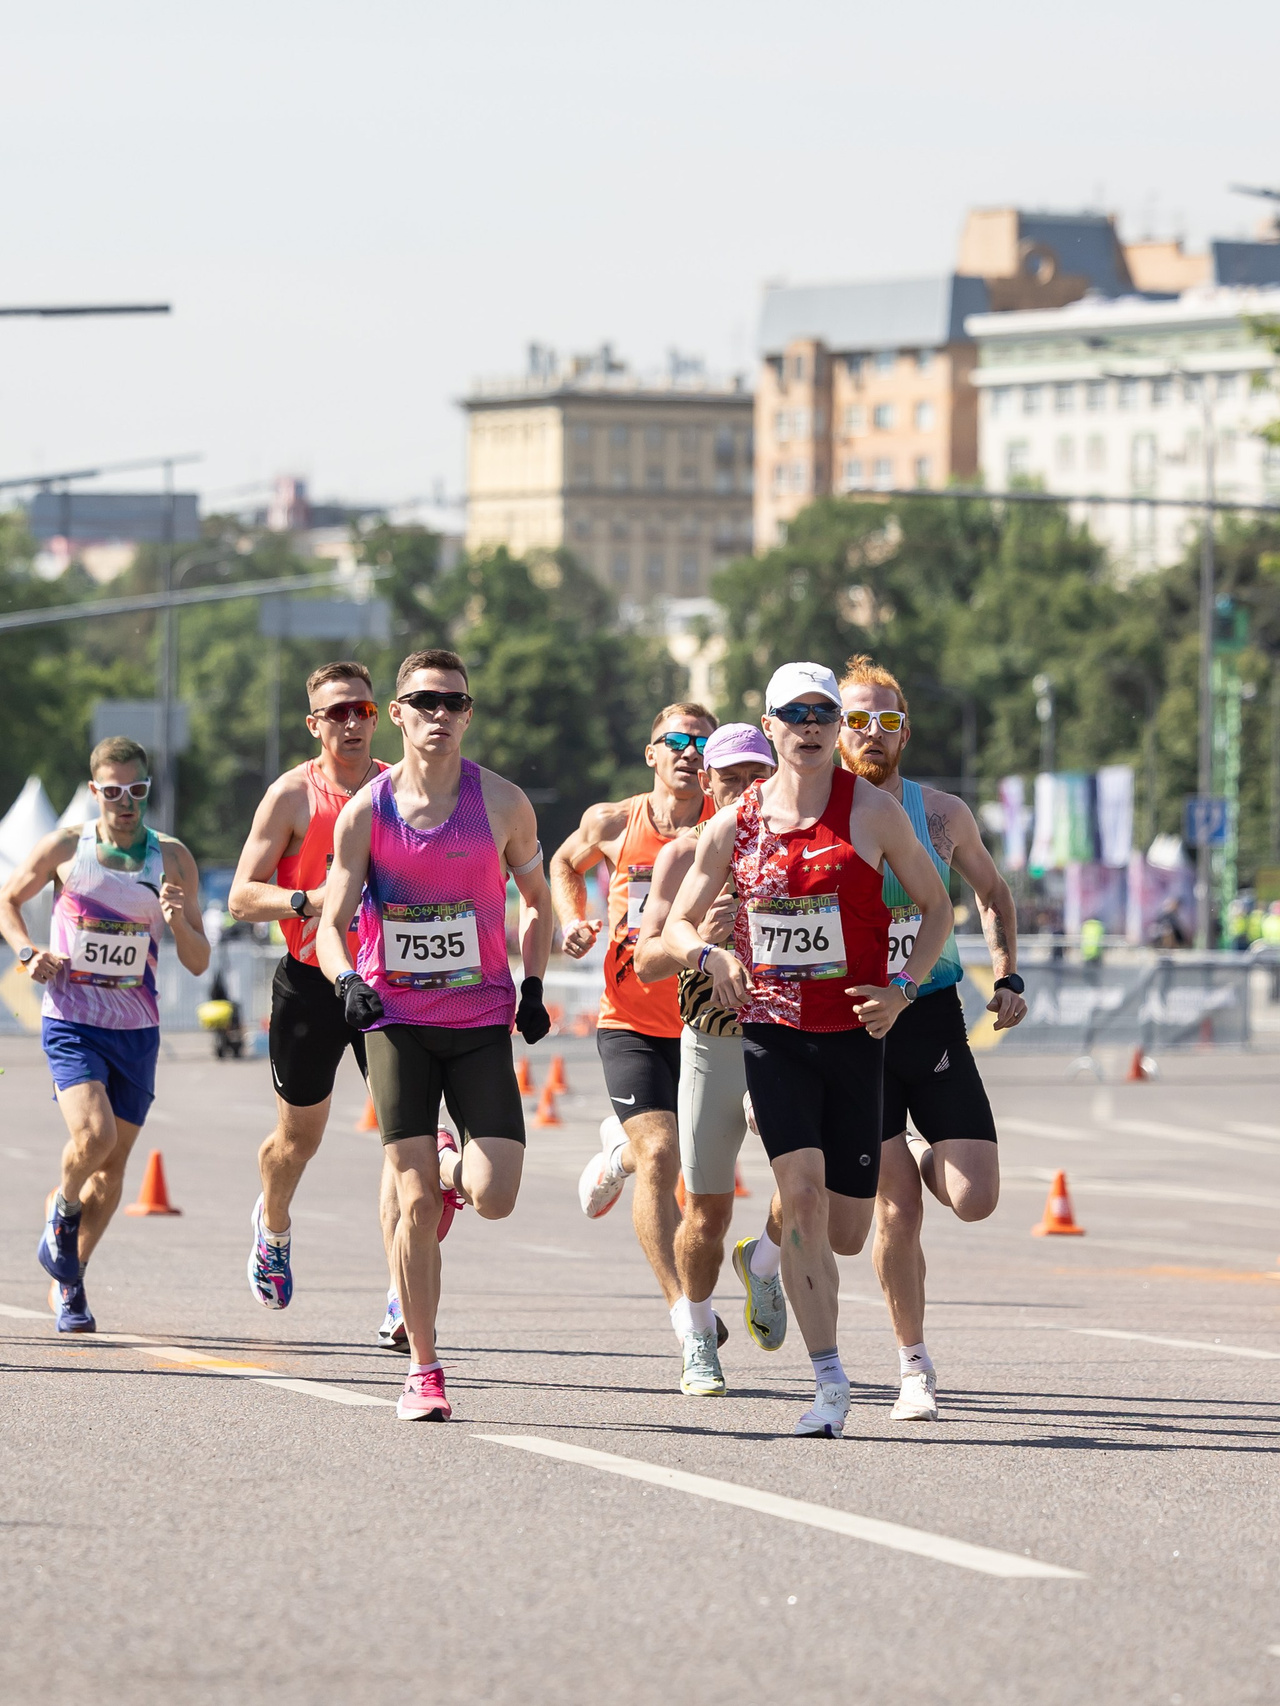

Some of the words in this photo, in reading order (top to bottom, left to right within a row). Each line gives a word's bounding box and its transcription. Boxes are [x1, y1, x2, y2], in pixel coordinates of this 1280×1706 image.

[433, 911, 473, 922] 2026
[796, 906, 838, 916] 2026
[396, 931, 465, 960] 7535
[761, 926, 830, 953] 7736
[84, 942, 137, 966] 5140
